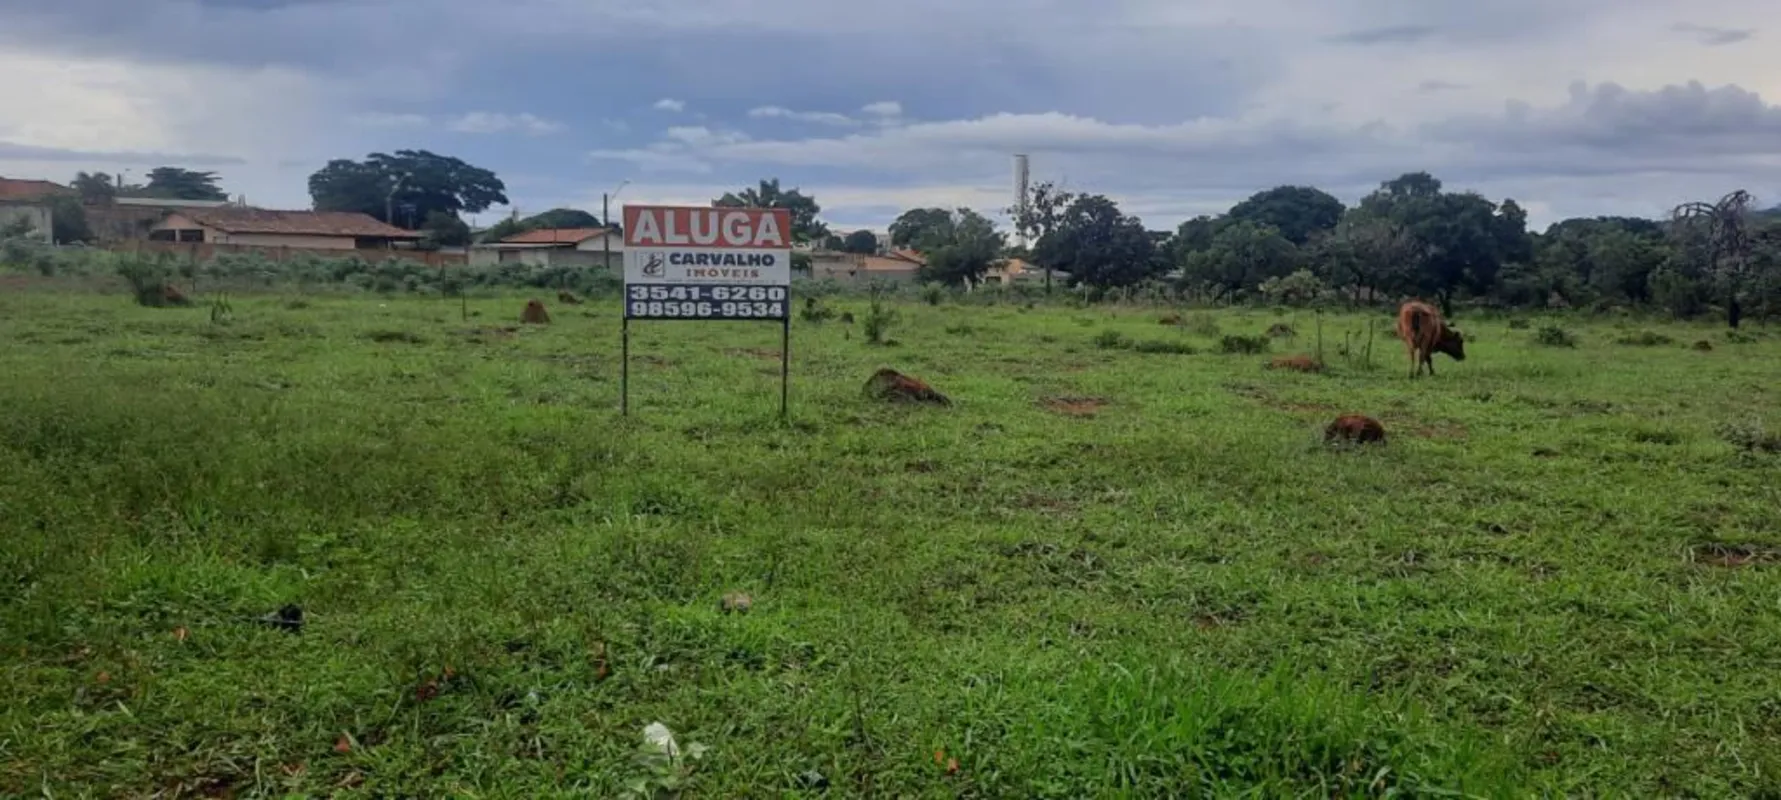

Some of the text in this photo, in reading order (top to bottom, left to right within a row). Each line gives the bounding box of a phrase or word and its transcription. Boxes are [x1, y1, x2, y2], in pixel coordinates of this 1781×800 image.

[632, 210, 783, 246] ALUGA
[669, 252, 775, 267] CARVALHO
[630, 286, 786, 301] 3541-6260
[631, 301, 783, 317] 98596-9534
